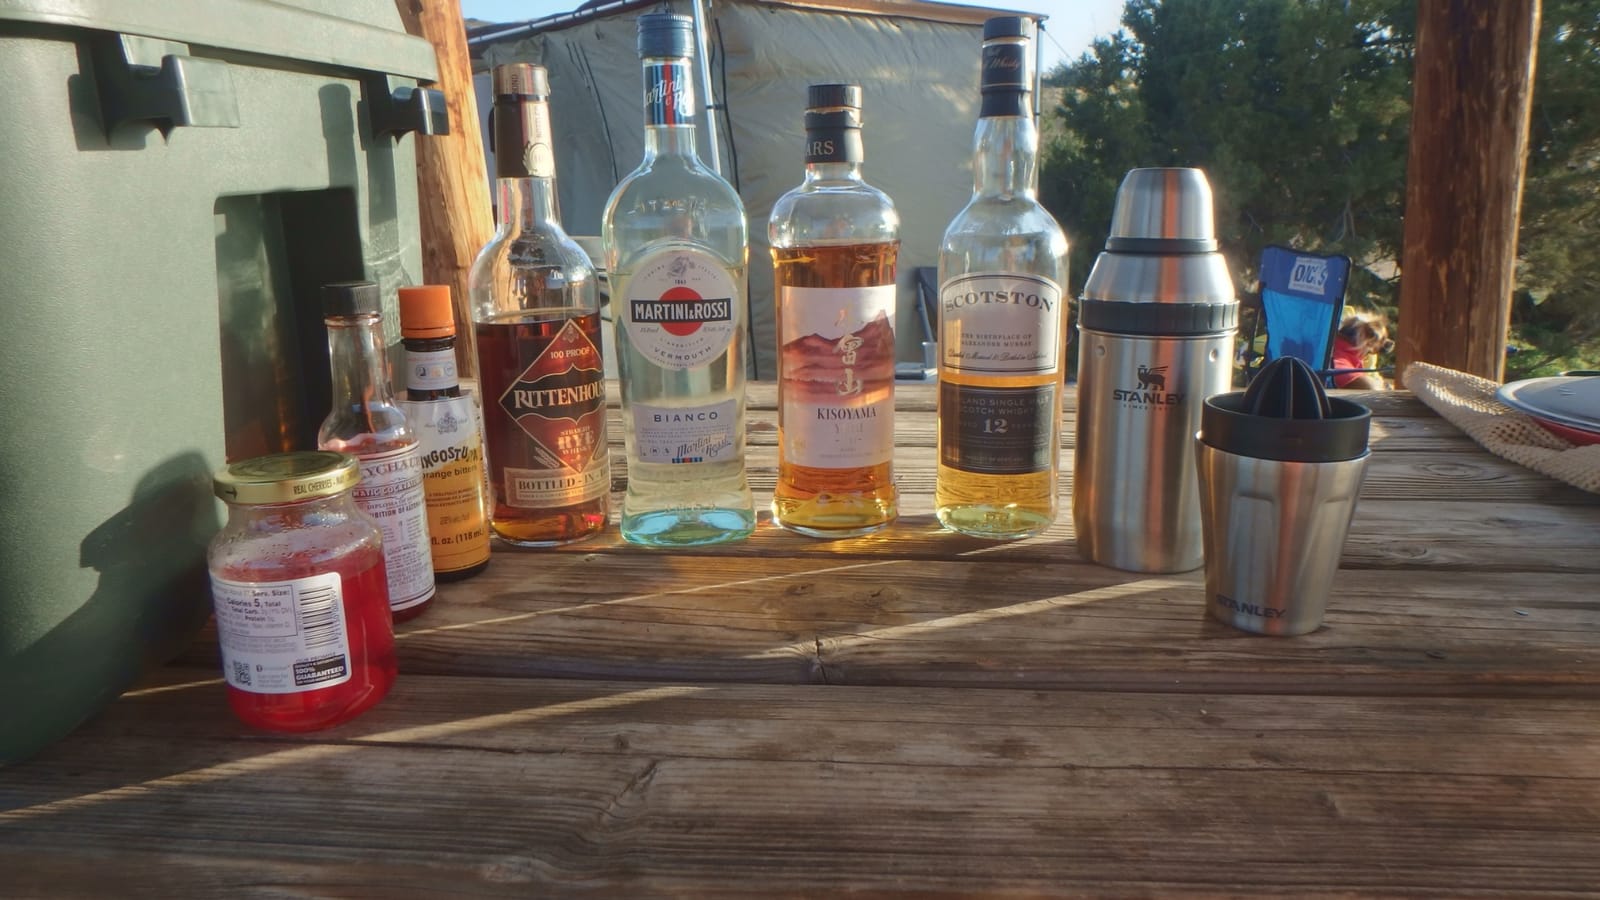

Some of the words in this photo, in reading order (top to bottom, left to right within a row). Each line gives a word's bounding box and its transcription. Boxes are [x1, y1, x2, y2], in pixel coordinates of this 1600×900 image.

[645, 74, 681, 106] artini
[805, 140, 834, 156] ARS
[945, 291, 1053, 313] SCOTSTON
[634, 302, 728, 320] MARTINI&ROSSI
[550, 351, 564, 360] 100
[566, 346, 590, 358] PROOF
[654, 346, 712, 361] VERMOUTH
[514, 380, 605, 409] RITTENHOUS
[1112, 389, 1186, 406] STANLEY
[653, 411, 719, 423] BIANCO
[817, 407, 877, 420] KISOYAMA
[961, 406, 995, 415] COTCH
[983, 418, 1009, 434] 12
[441, 537, 454, 545] oz.
[1215, 593, 1288, 618] STANLEY
